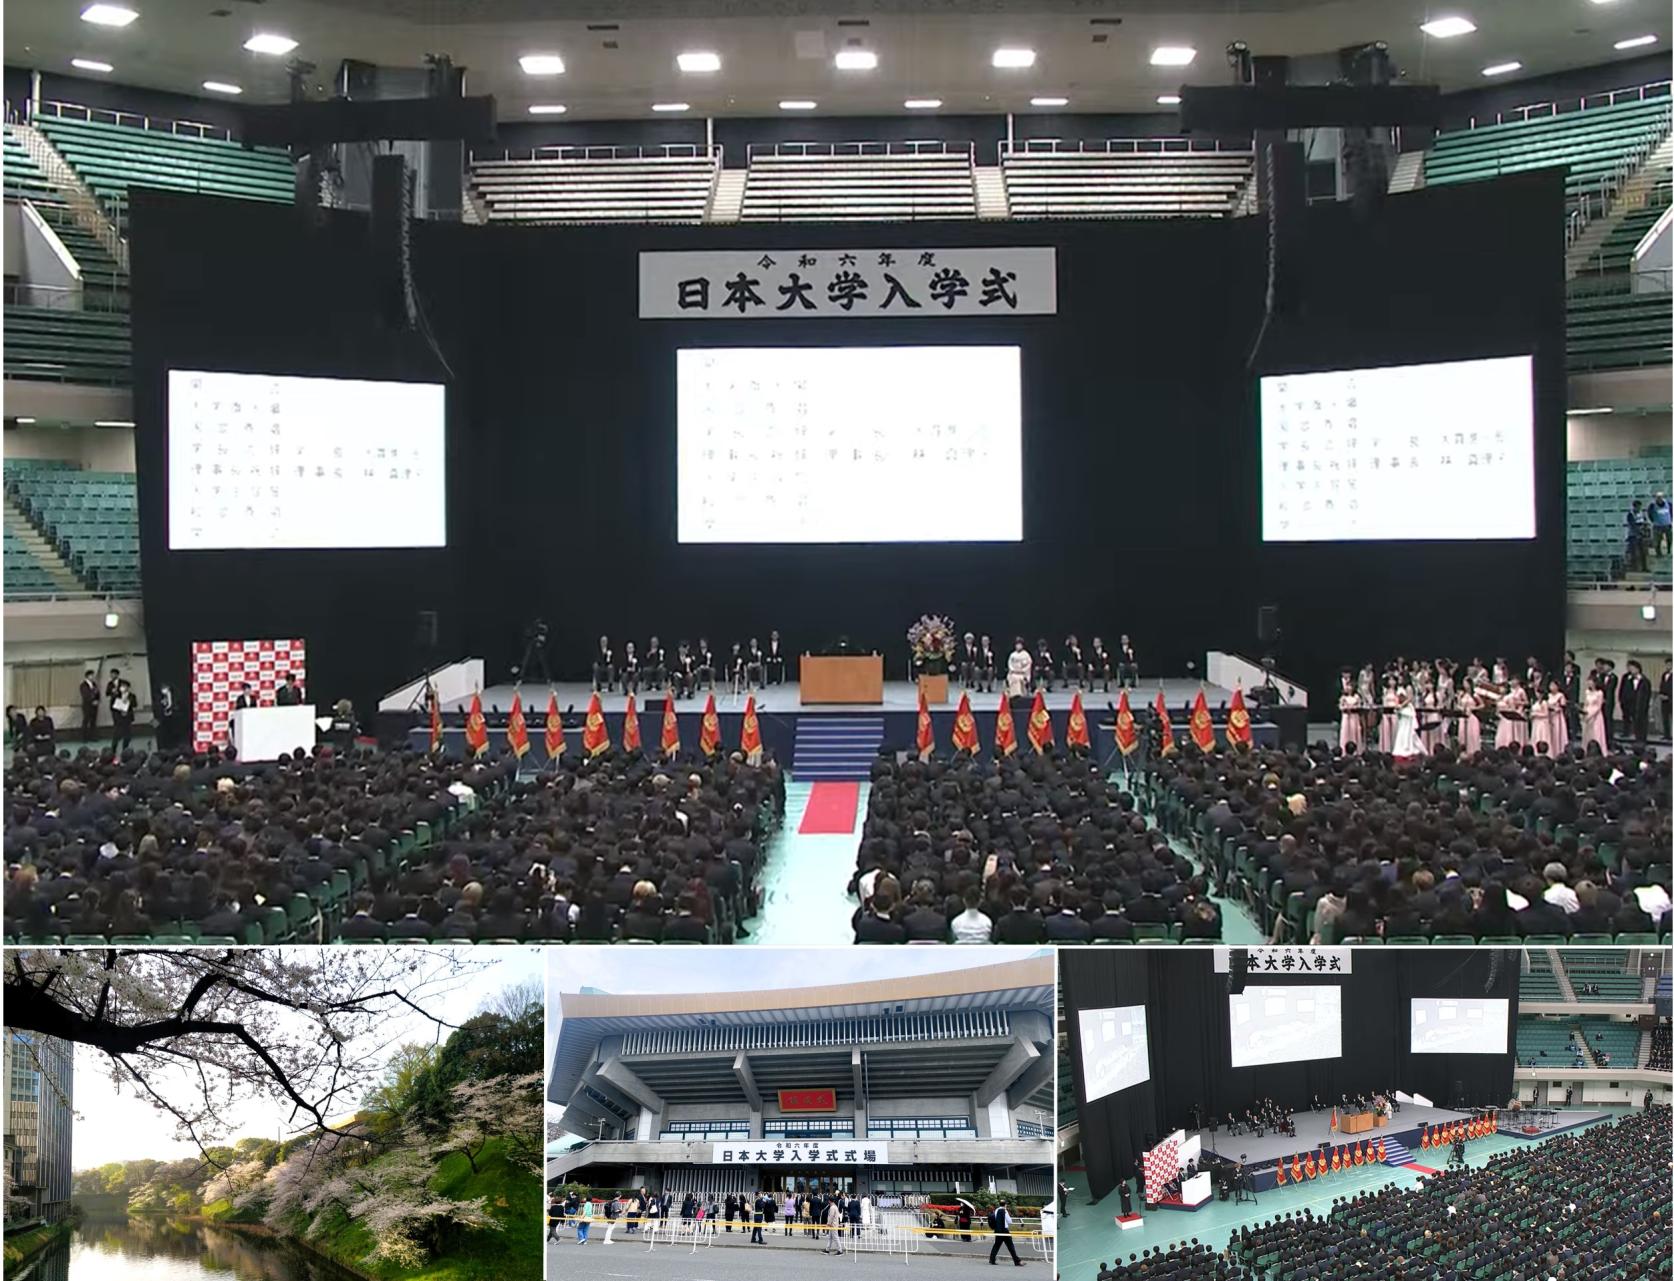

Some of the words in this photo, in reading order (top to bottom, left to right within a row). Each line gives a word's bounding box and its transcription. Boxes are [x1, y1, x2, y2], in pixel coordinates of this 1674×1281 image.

[757, 252, 936, 269] 令和六年度
[677, 267, 1019, 313] 日本大学入学式
[722, 1150, 877, 1162] 日本大学入学式式場
